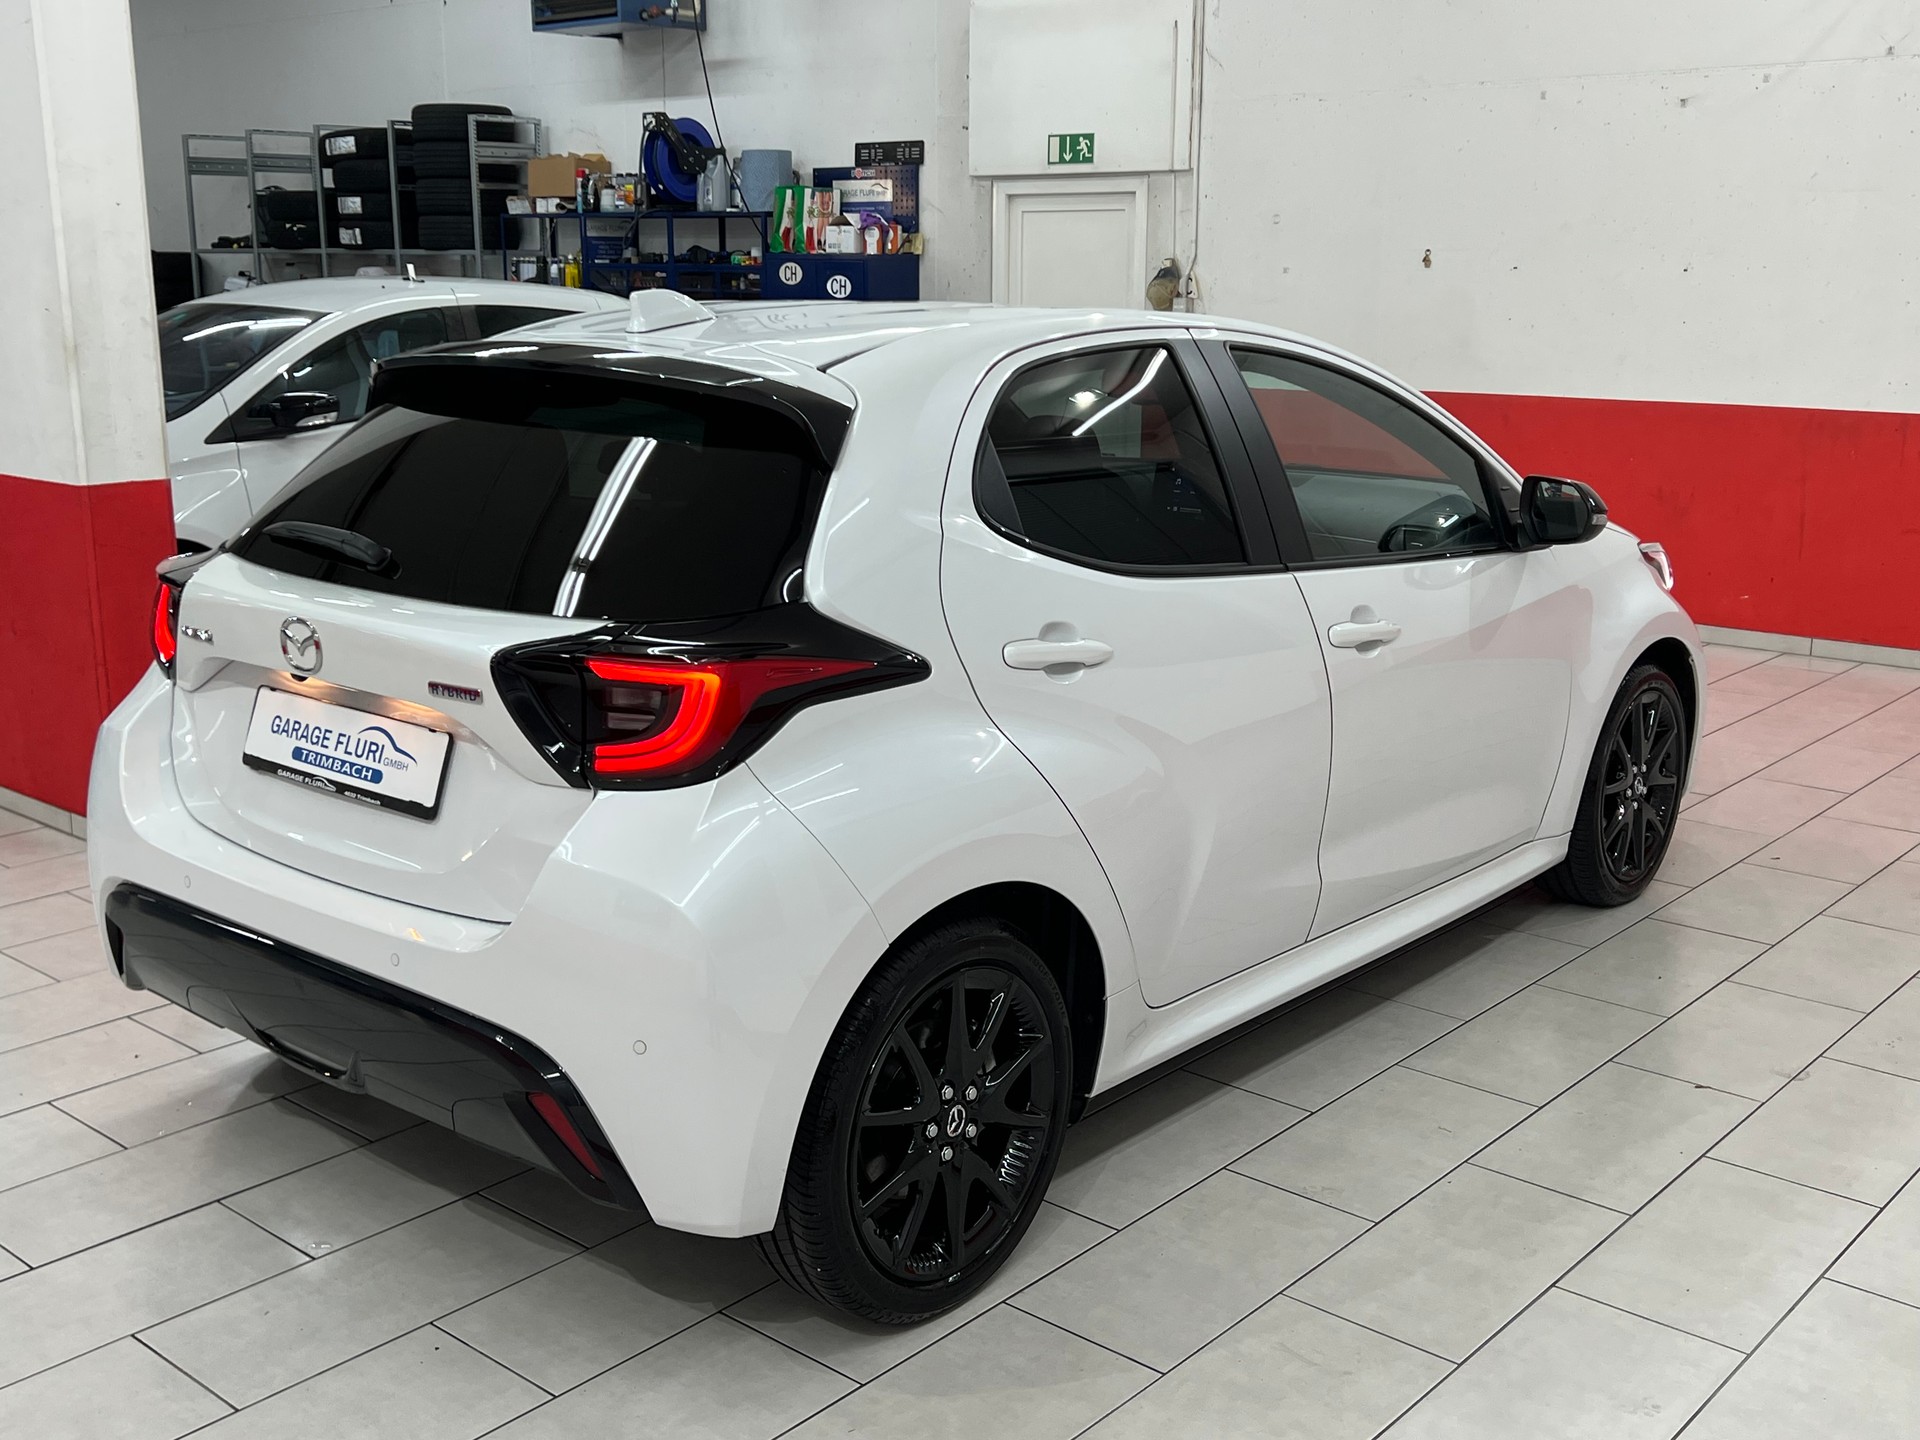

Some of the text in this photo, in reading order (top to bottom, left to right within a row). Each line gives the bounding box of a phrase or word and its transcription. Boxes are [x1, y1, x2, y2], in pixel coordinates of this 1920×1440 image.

[784, 265, 797, 282] CH
[831, 278, 847, 295] CH
[431, 685, 477, 702] HYBRID
[271, 715, 409, 772] GARAGE FLURI GMBH
[301, 750, 373, 780] TRIMBACH
[277, 769, 325, 788] GARAGE FLURI
